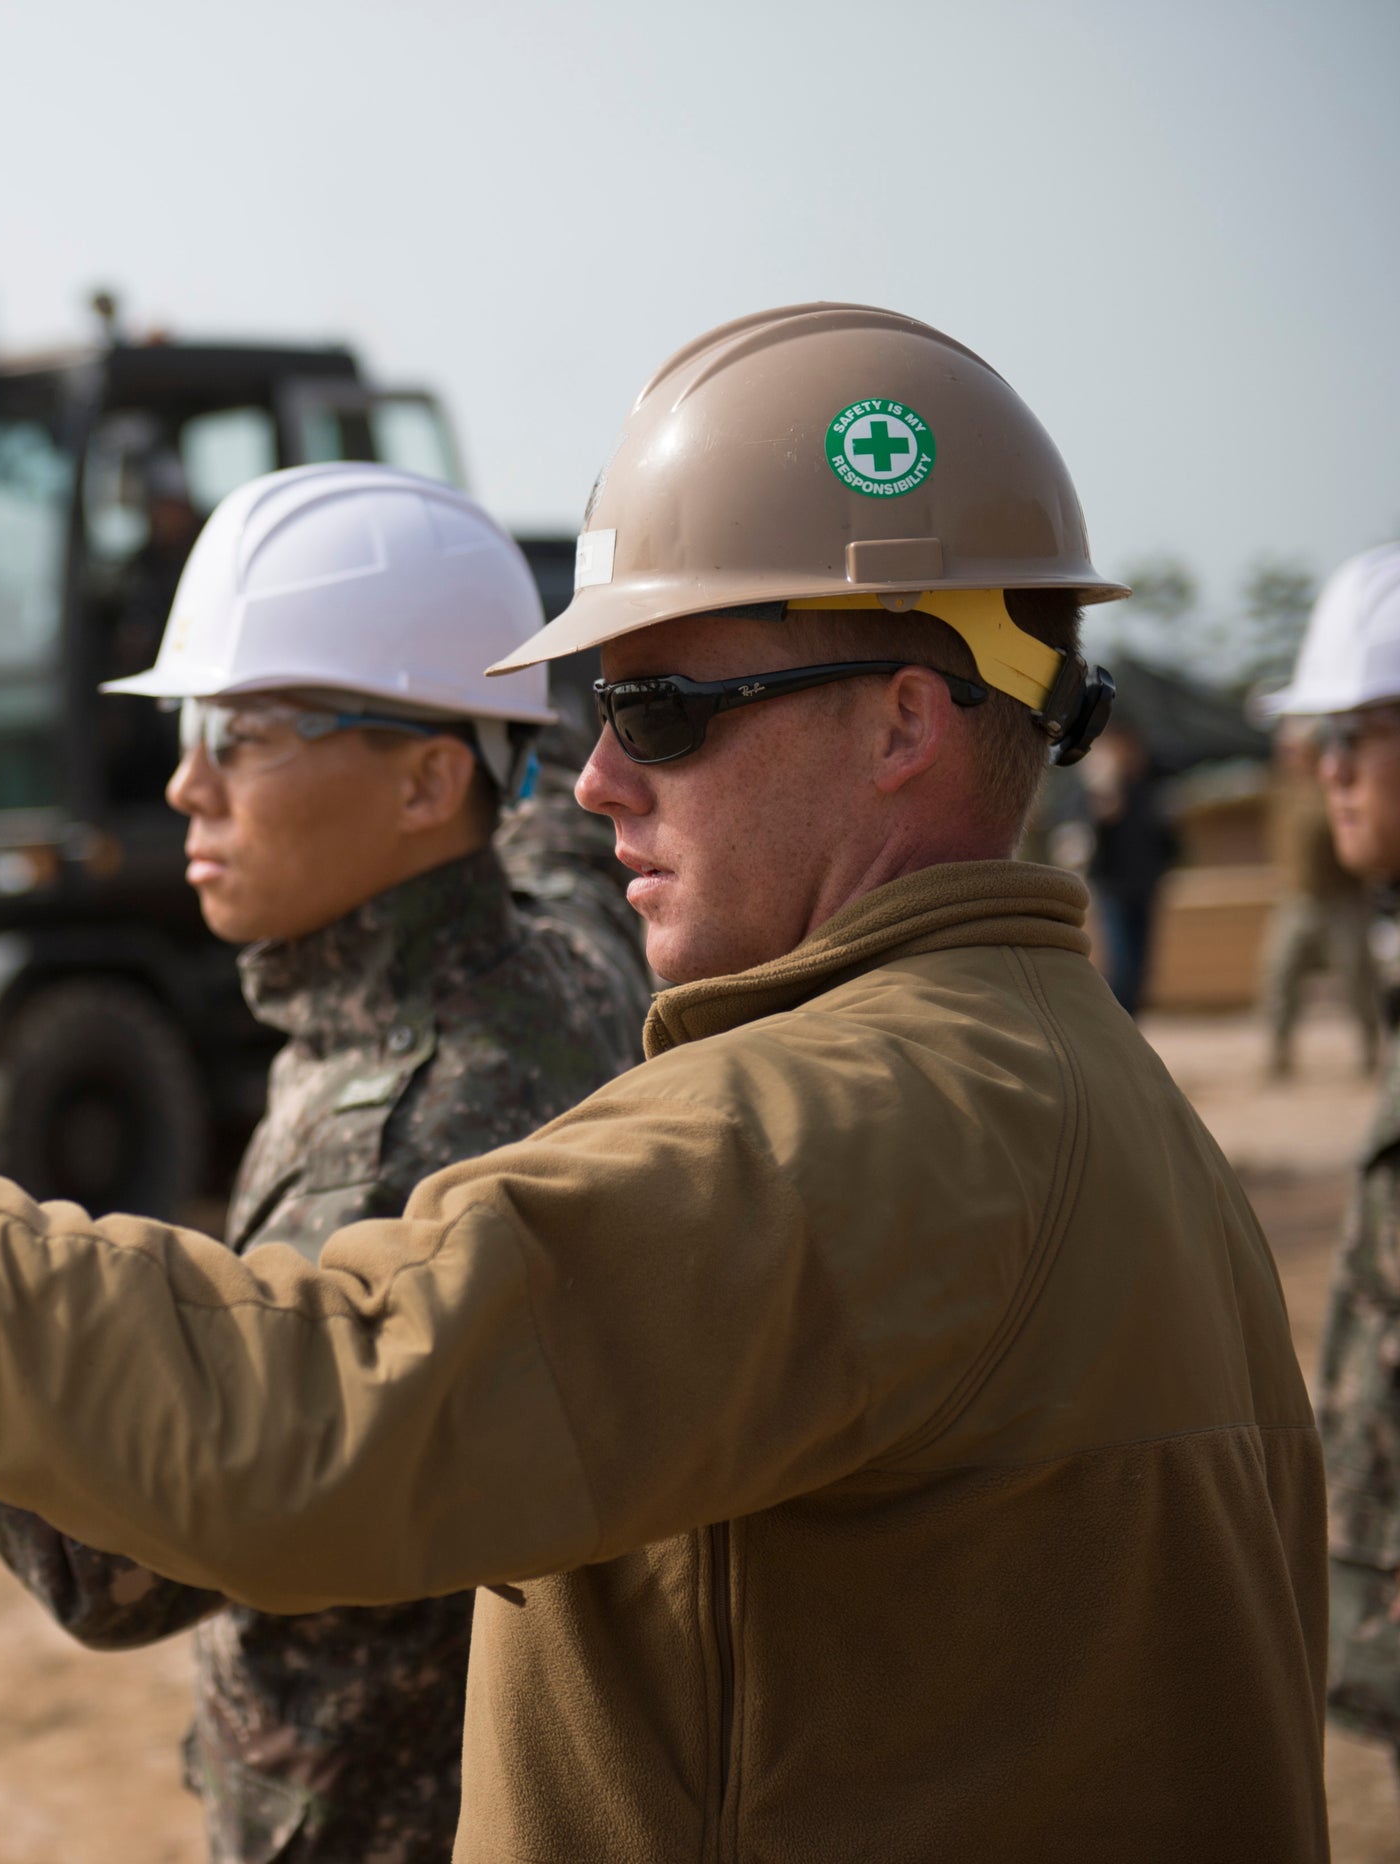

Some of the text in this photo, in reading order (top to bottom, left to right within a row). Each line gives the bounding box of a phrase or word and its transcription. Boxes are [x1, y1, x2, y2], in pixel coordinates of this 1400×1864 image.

[833, 400, 926, 433] SAFETY IS MY
[832, 453, 931, 495] RESPONSIBILITY
